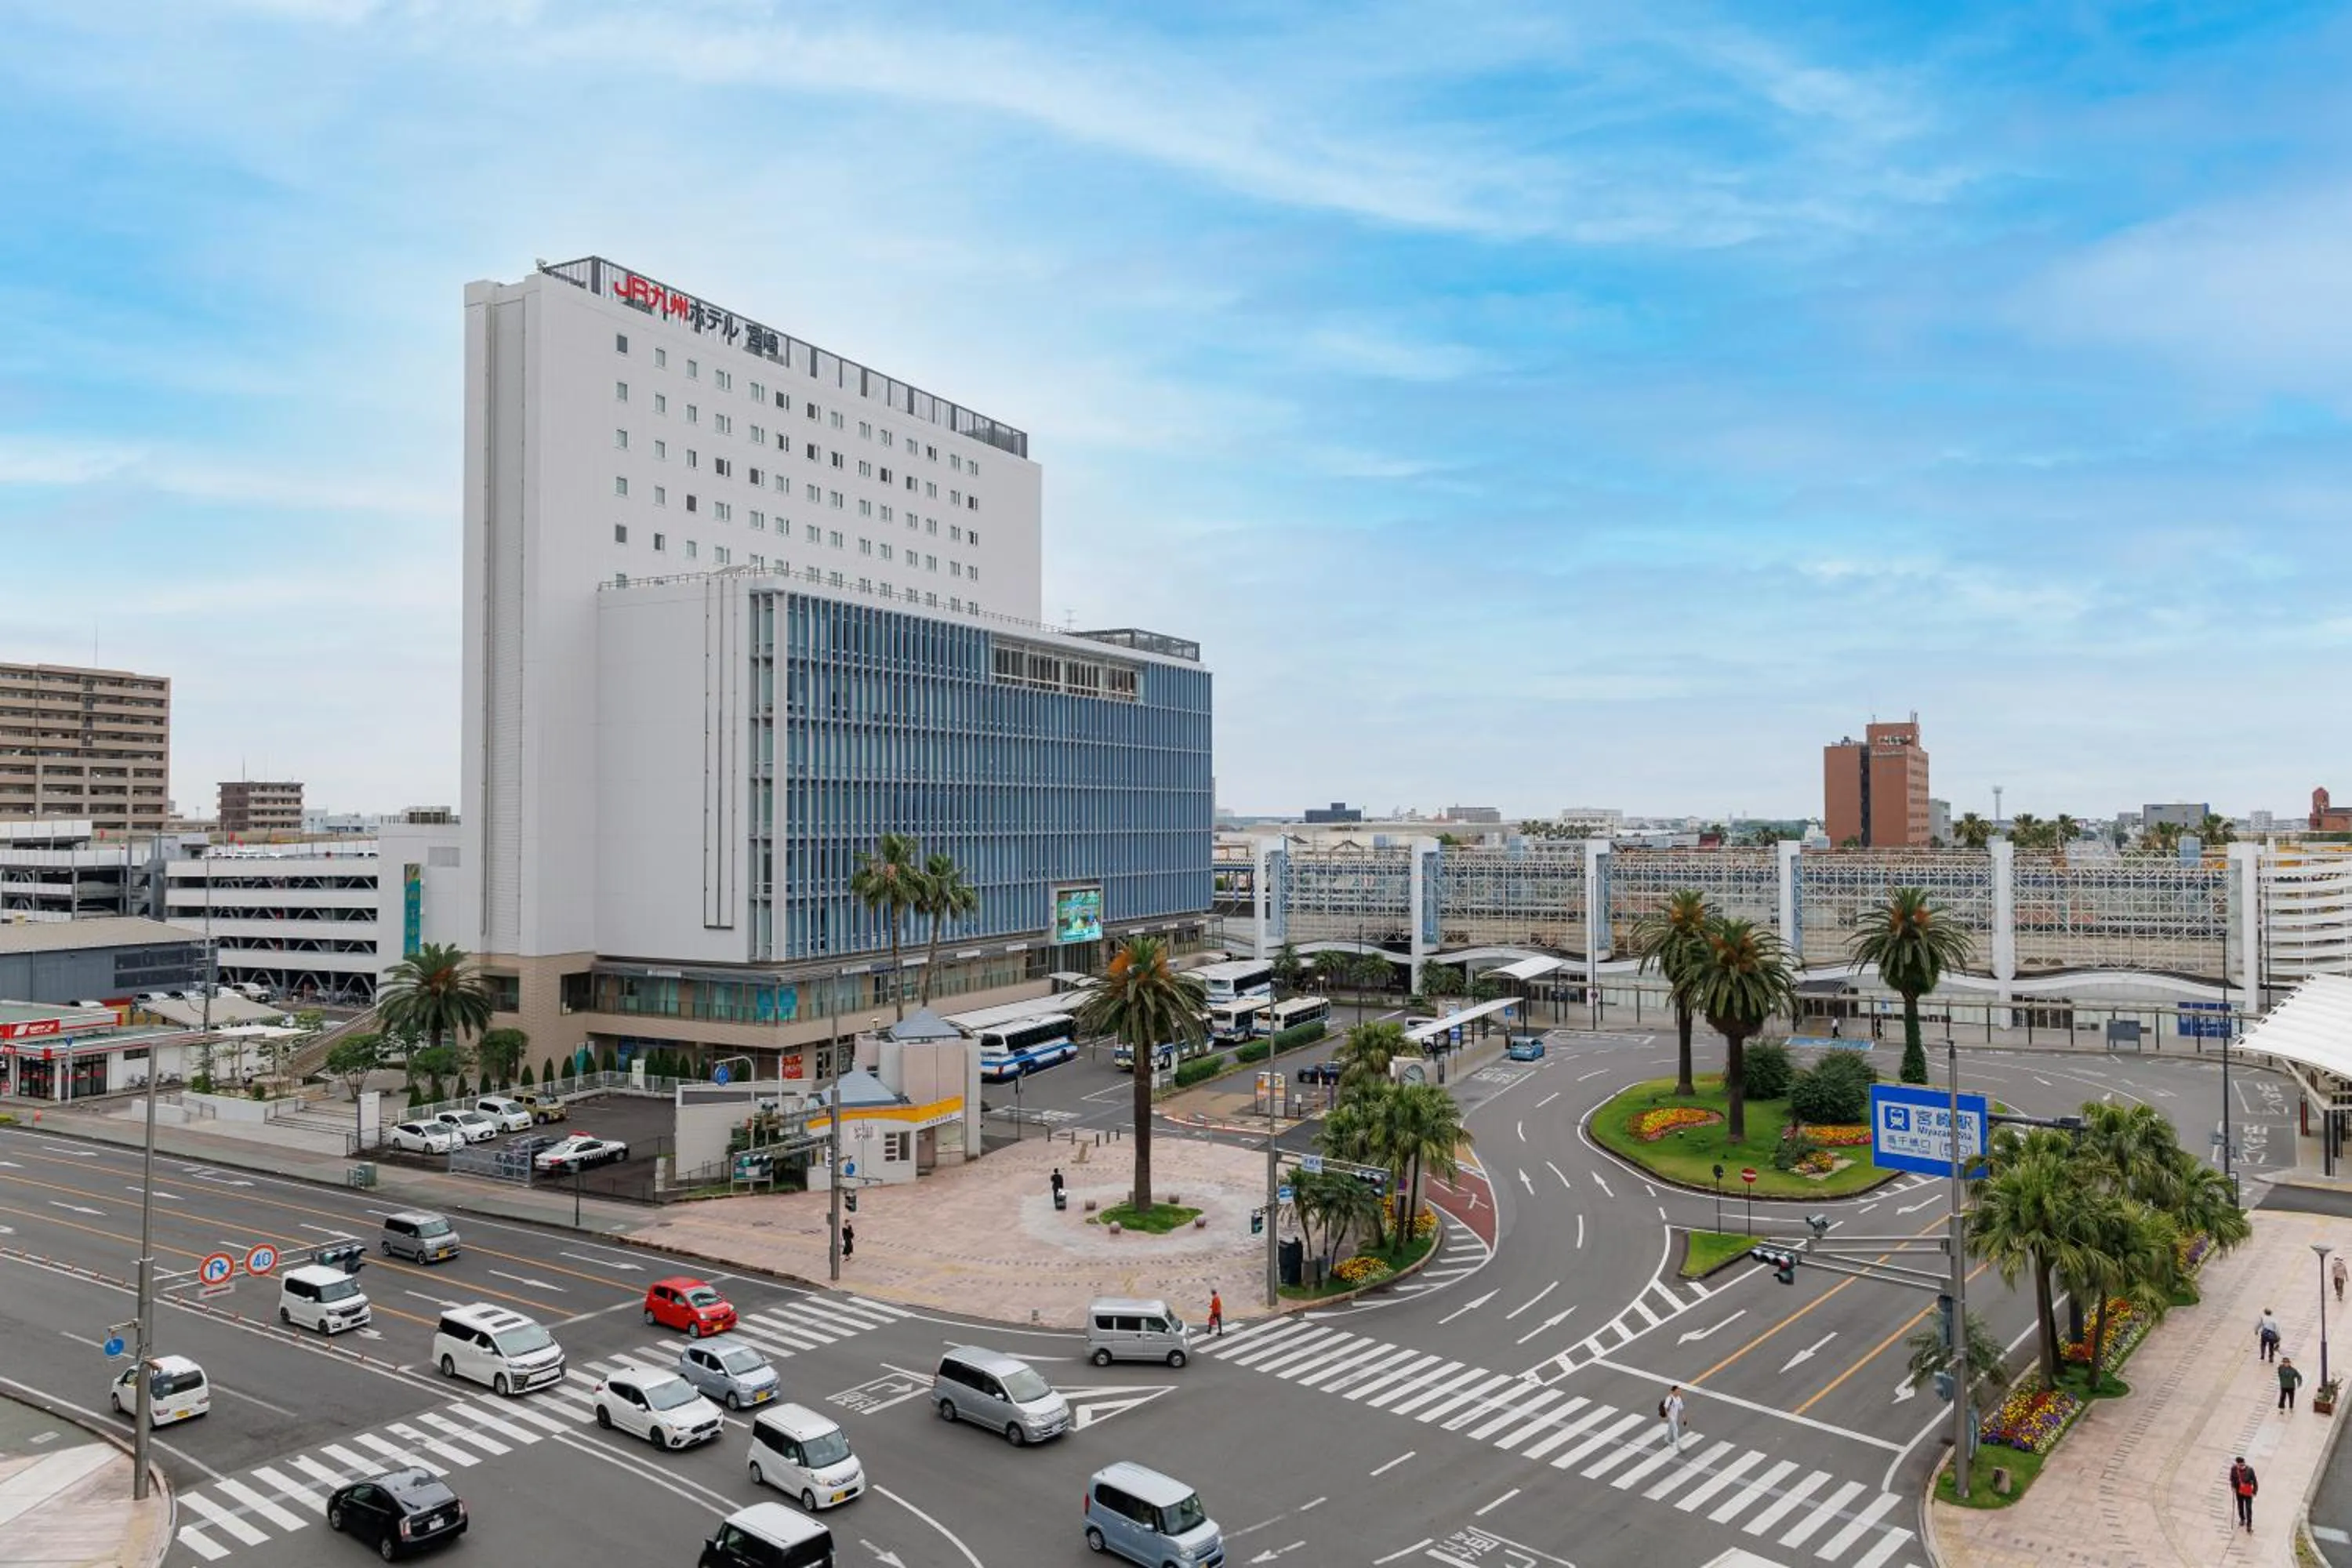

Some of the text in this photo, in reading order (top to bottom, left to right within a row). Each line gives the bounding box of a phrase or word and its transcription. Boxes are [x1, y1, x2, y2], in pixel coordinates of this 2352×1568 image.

[1915, 1109, 1973, 1131] 宮崎駅
[252, 1251, 272, 1268] 40
